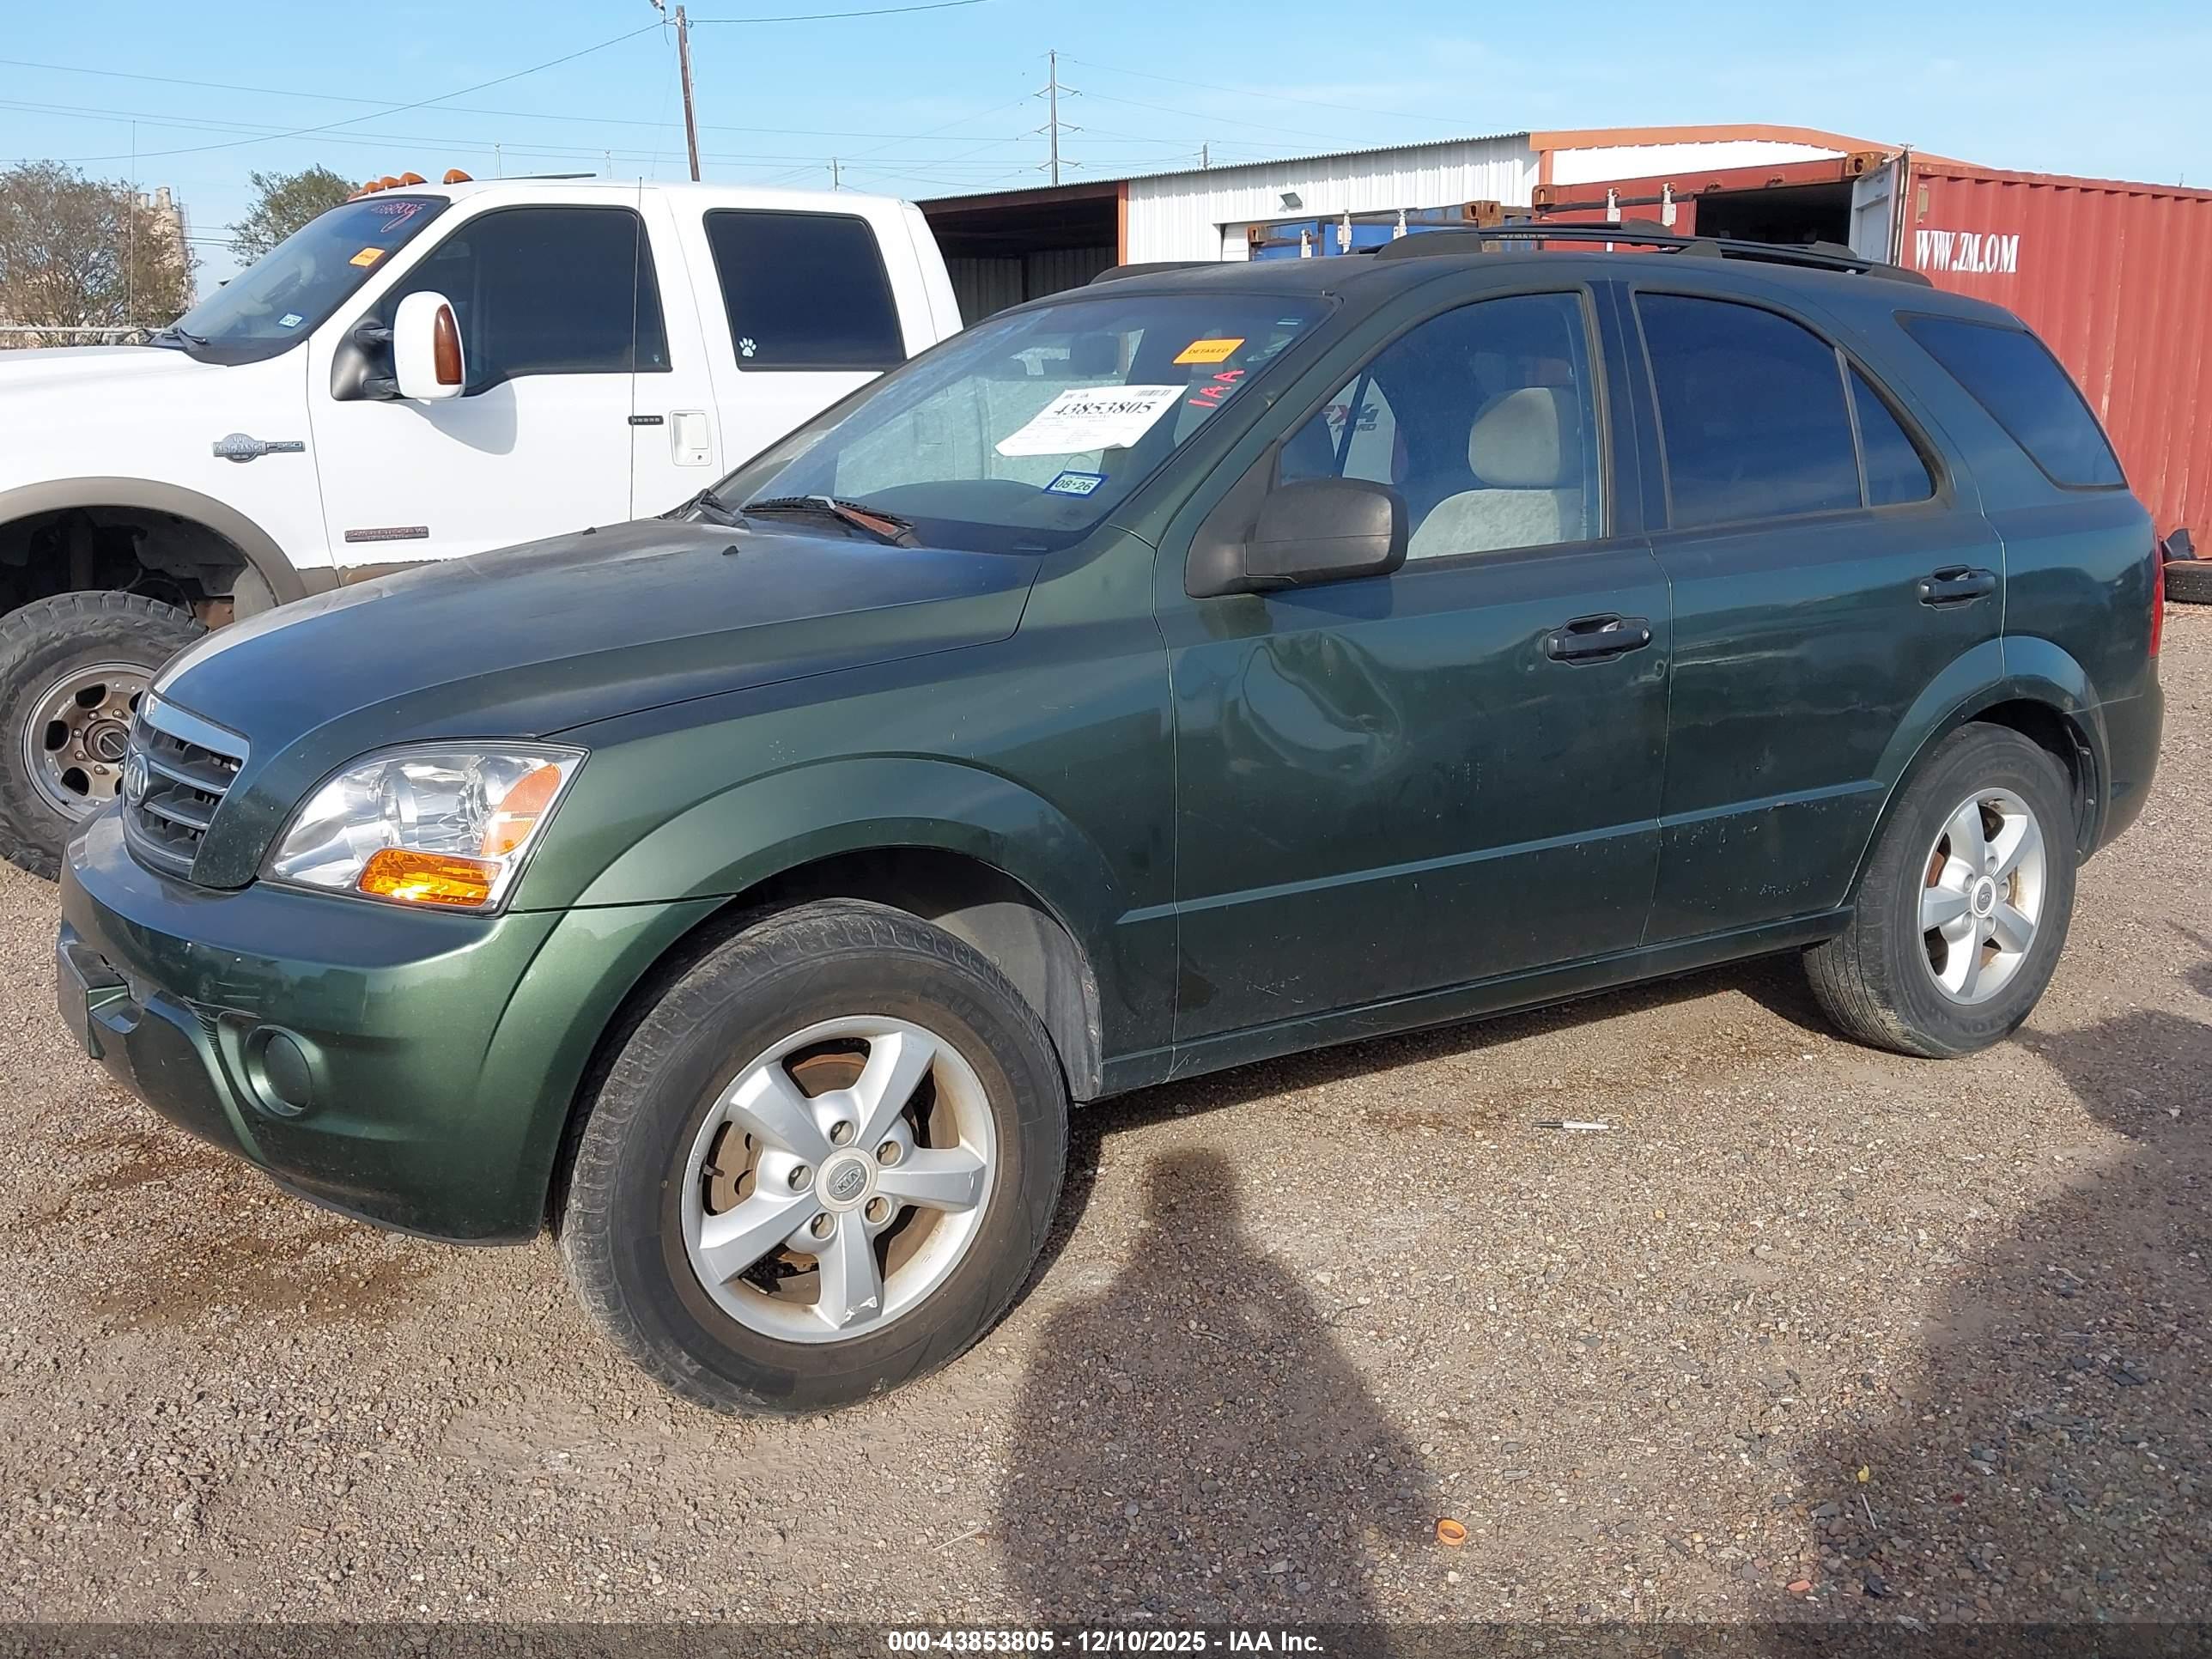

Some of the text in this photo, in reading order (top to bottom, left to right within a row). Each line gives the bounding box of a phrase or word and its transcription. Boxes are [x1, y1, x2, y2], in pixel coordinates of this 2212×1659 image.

[1188, 370, 1244, 408] IAA
[1052, 401, 1158, 416] 43853805
[837, 1170, 859, 1191] KIA
